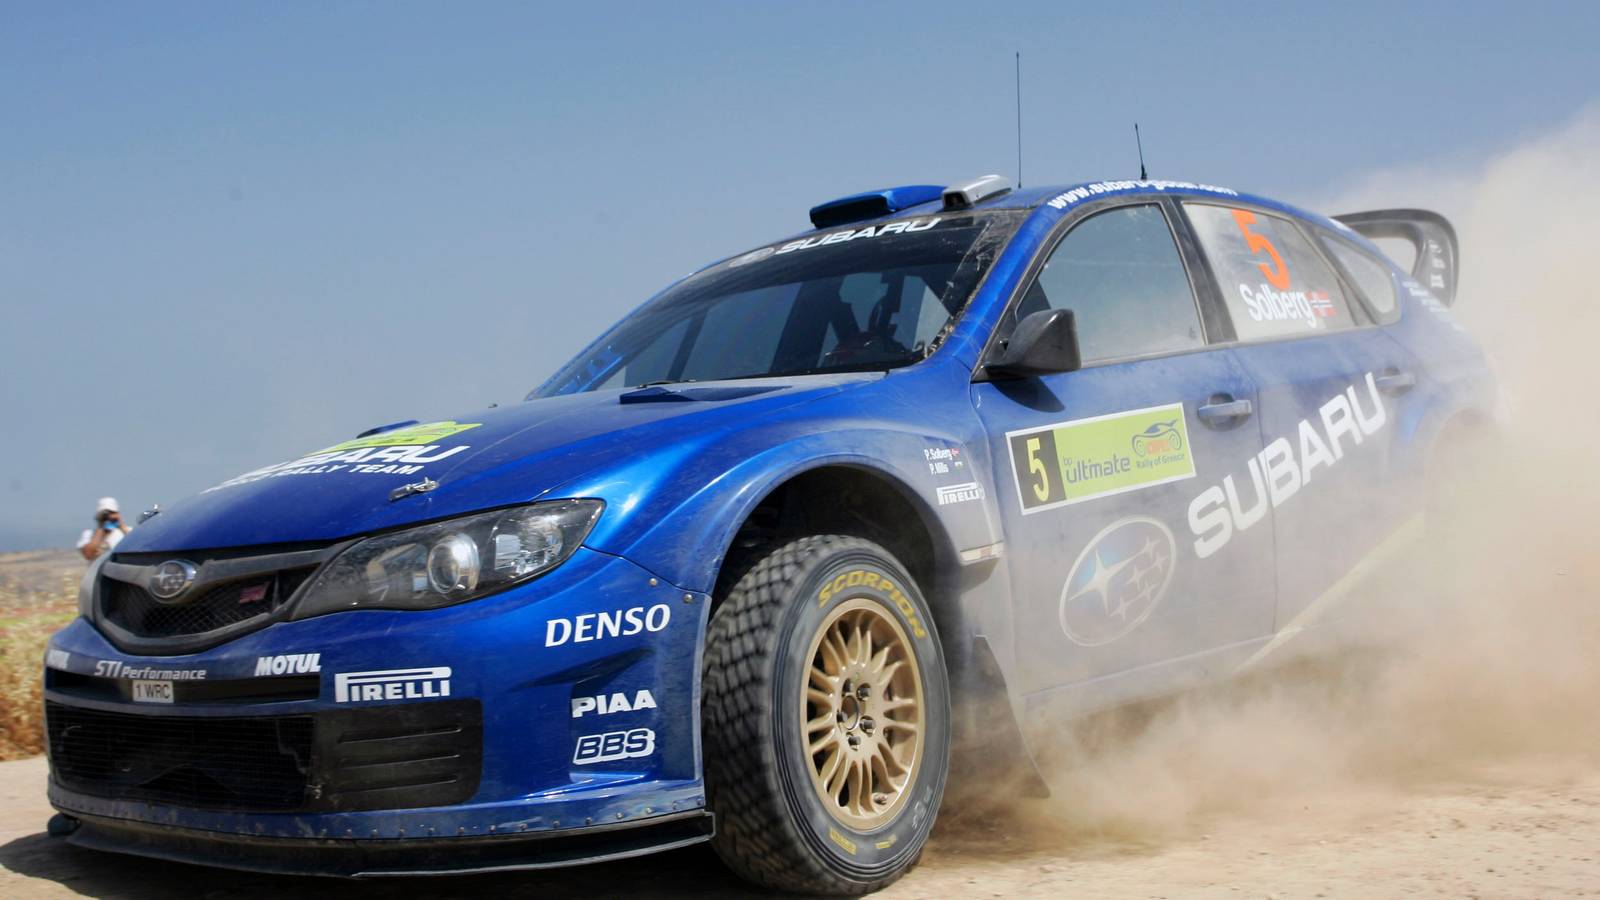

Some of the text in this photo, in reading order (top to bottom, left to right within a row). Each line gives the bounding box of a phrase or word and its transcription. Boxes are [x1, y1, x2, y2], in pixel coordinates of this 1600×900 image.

[775, 217, 942, 255] SUBARU
[1231, 208, 1290, 291] 5
[1239, 283, 1317, 328] Solberg
[348, 464, 424, 475] TEAM
[1026, 437, 1050, 502] 5
[1066, 453, 1131, 484] ultimate
[1187, 371, 1386, 558] SUBARU
[936, 481, 985, 506] PIRELLI
[545, 603, 671, 648] DENSO
[121, 665, 206, 680] Performance
[254, 653, 321, 677] MOTUL
[135, 684, 170, 700] 1 WRC
[334, 667, 452, 703] PIRELLI
[571, 689, 657, 718] PIAA
[572, 728, 656, 766] BBS
